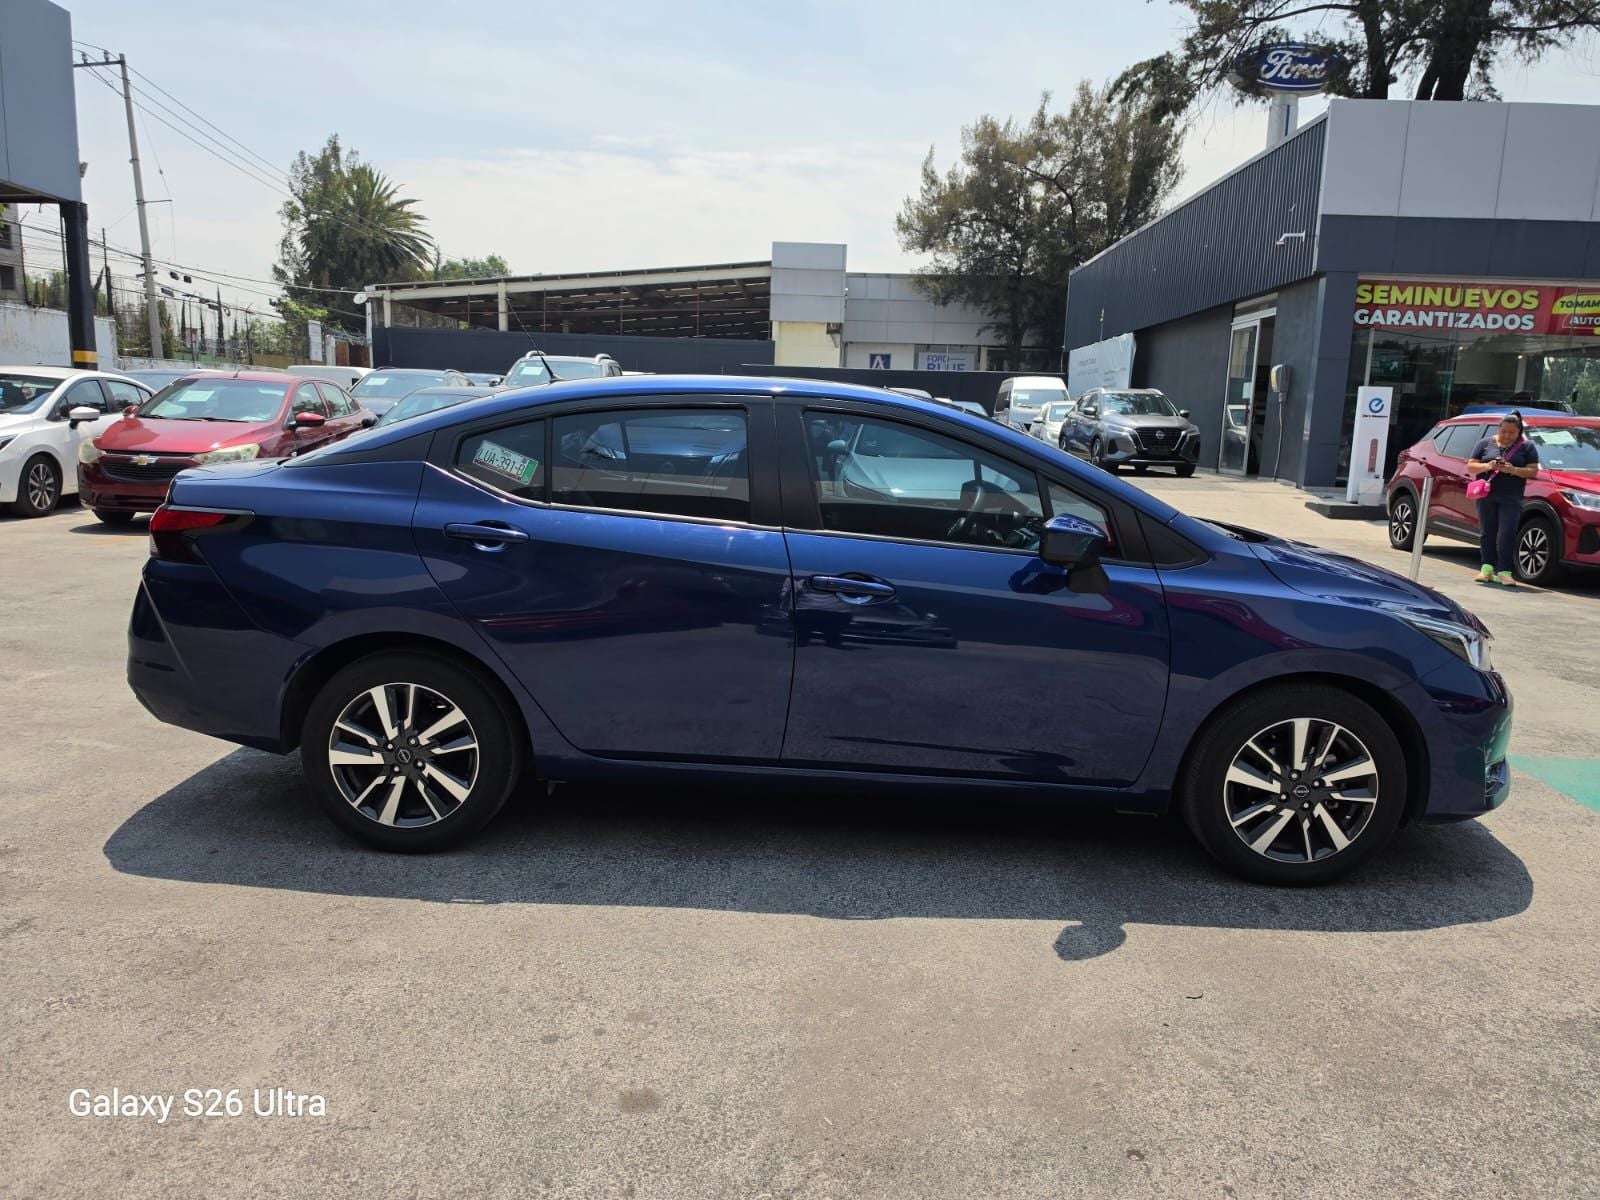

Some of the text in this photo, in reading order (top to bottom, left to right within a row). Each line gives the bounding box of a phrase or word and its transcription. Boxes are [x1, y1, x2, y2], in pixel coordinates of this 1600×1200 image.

[1260, 49, 1329, 79] Ford
[1355, 284, 1540, 310] SEMINUEVOS
[1354, 308, 1535, 330] GARANTIZADOS
